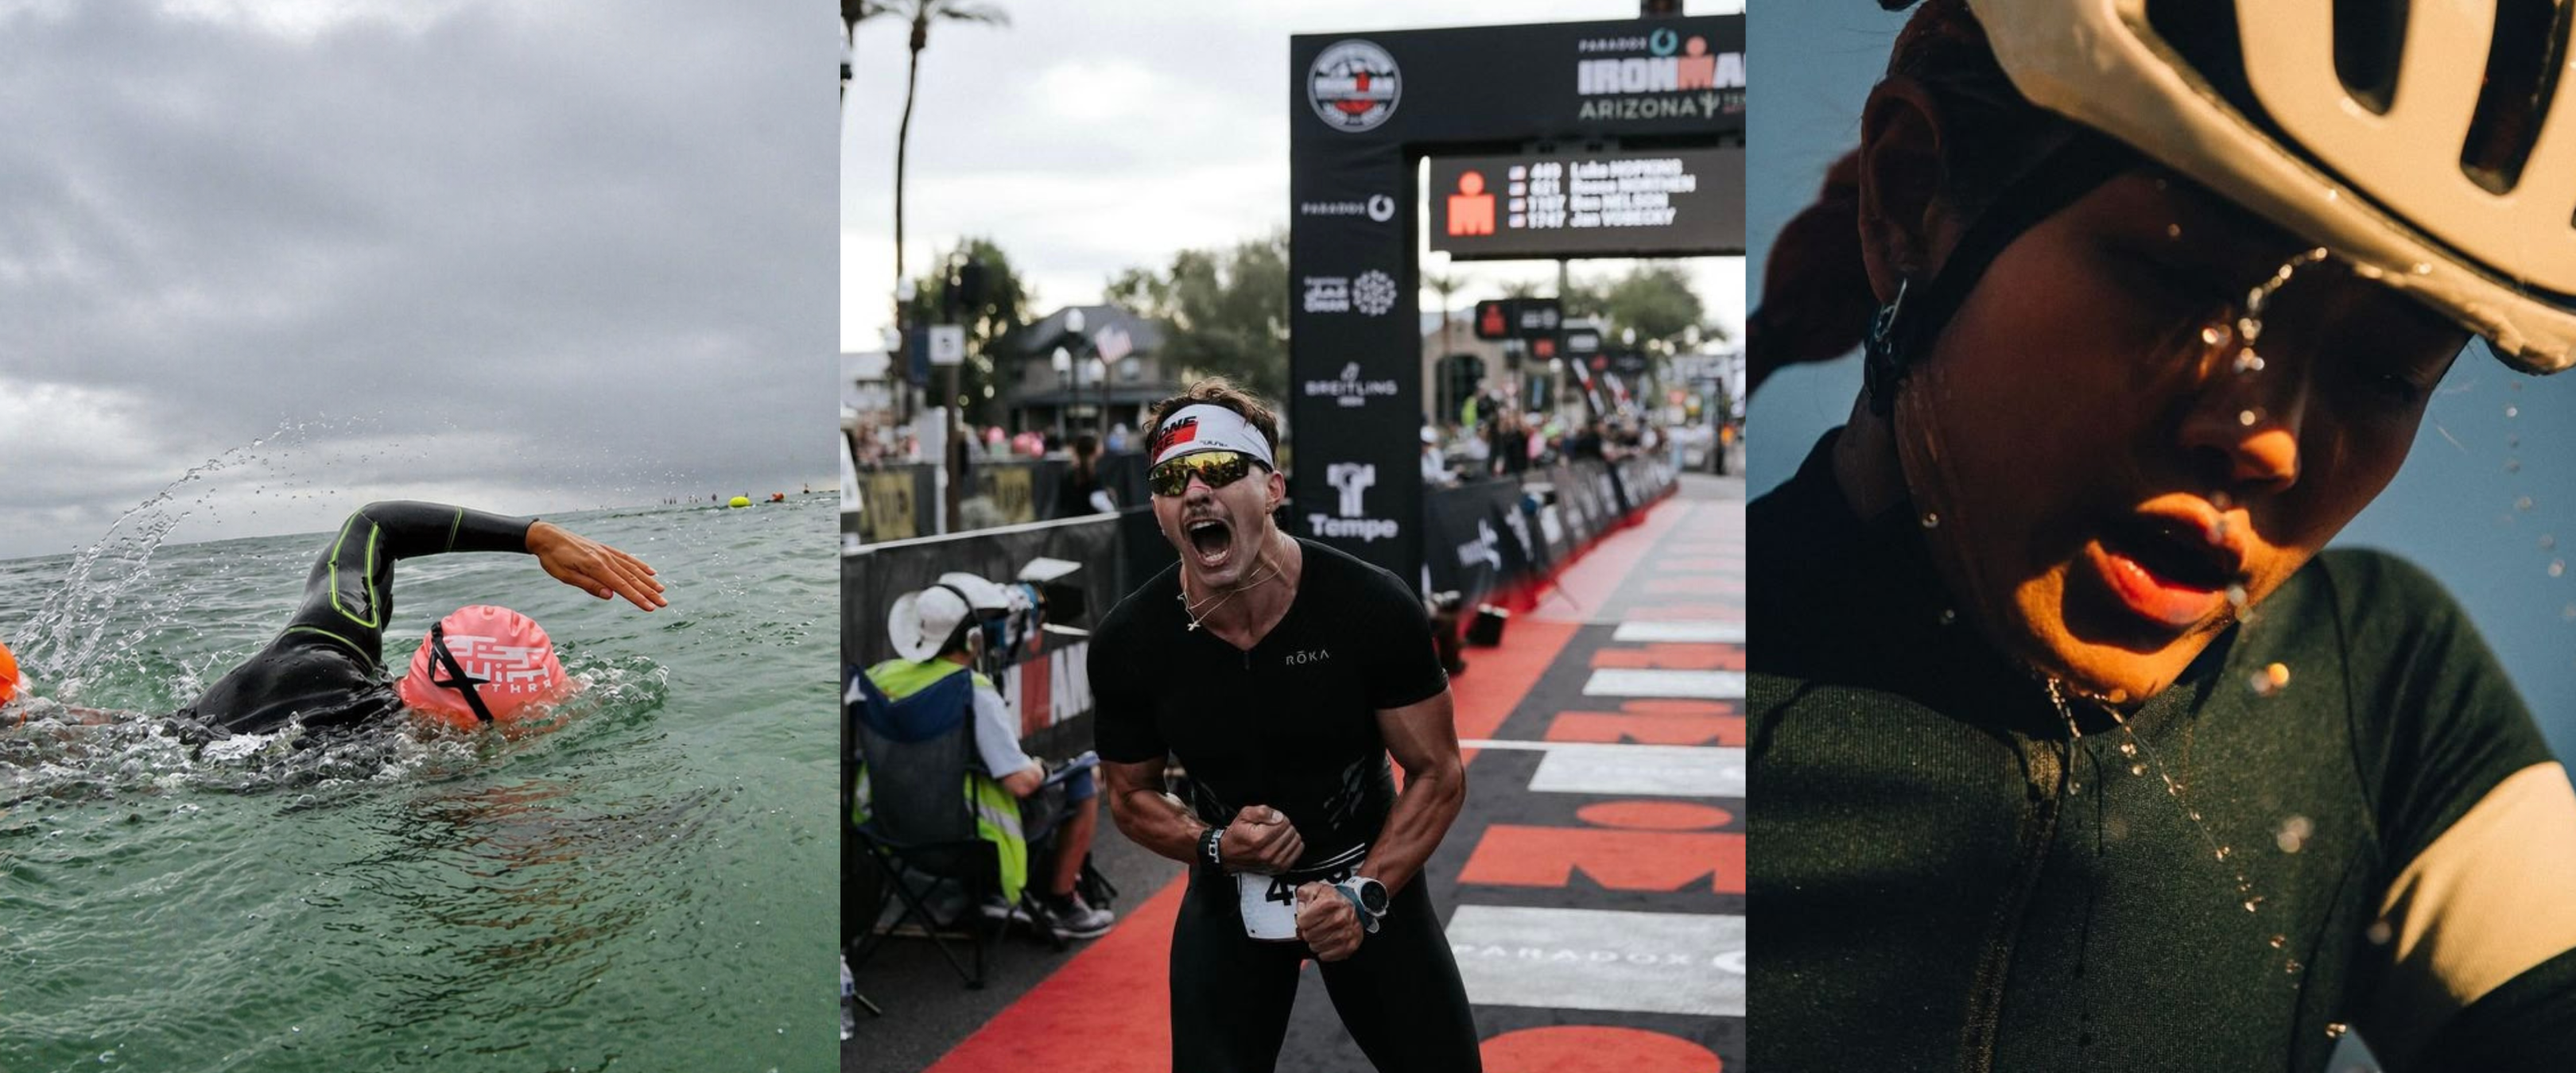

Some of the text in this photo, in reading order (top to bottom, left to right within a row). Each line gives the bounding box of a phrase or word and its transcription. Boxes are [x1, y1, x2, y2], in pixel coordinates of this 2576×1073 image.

[1578, 51, 1745, 95] IRONMA
[1580, 97, 1698, 120] ARIZONA
[1305, 380, 1398, 397] BREITLING
[1307, 513, 1399, 543] Tempe
